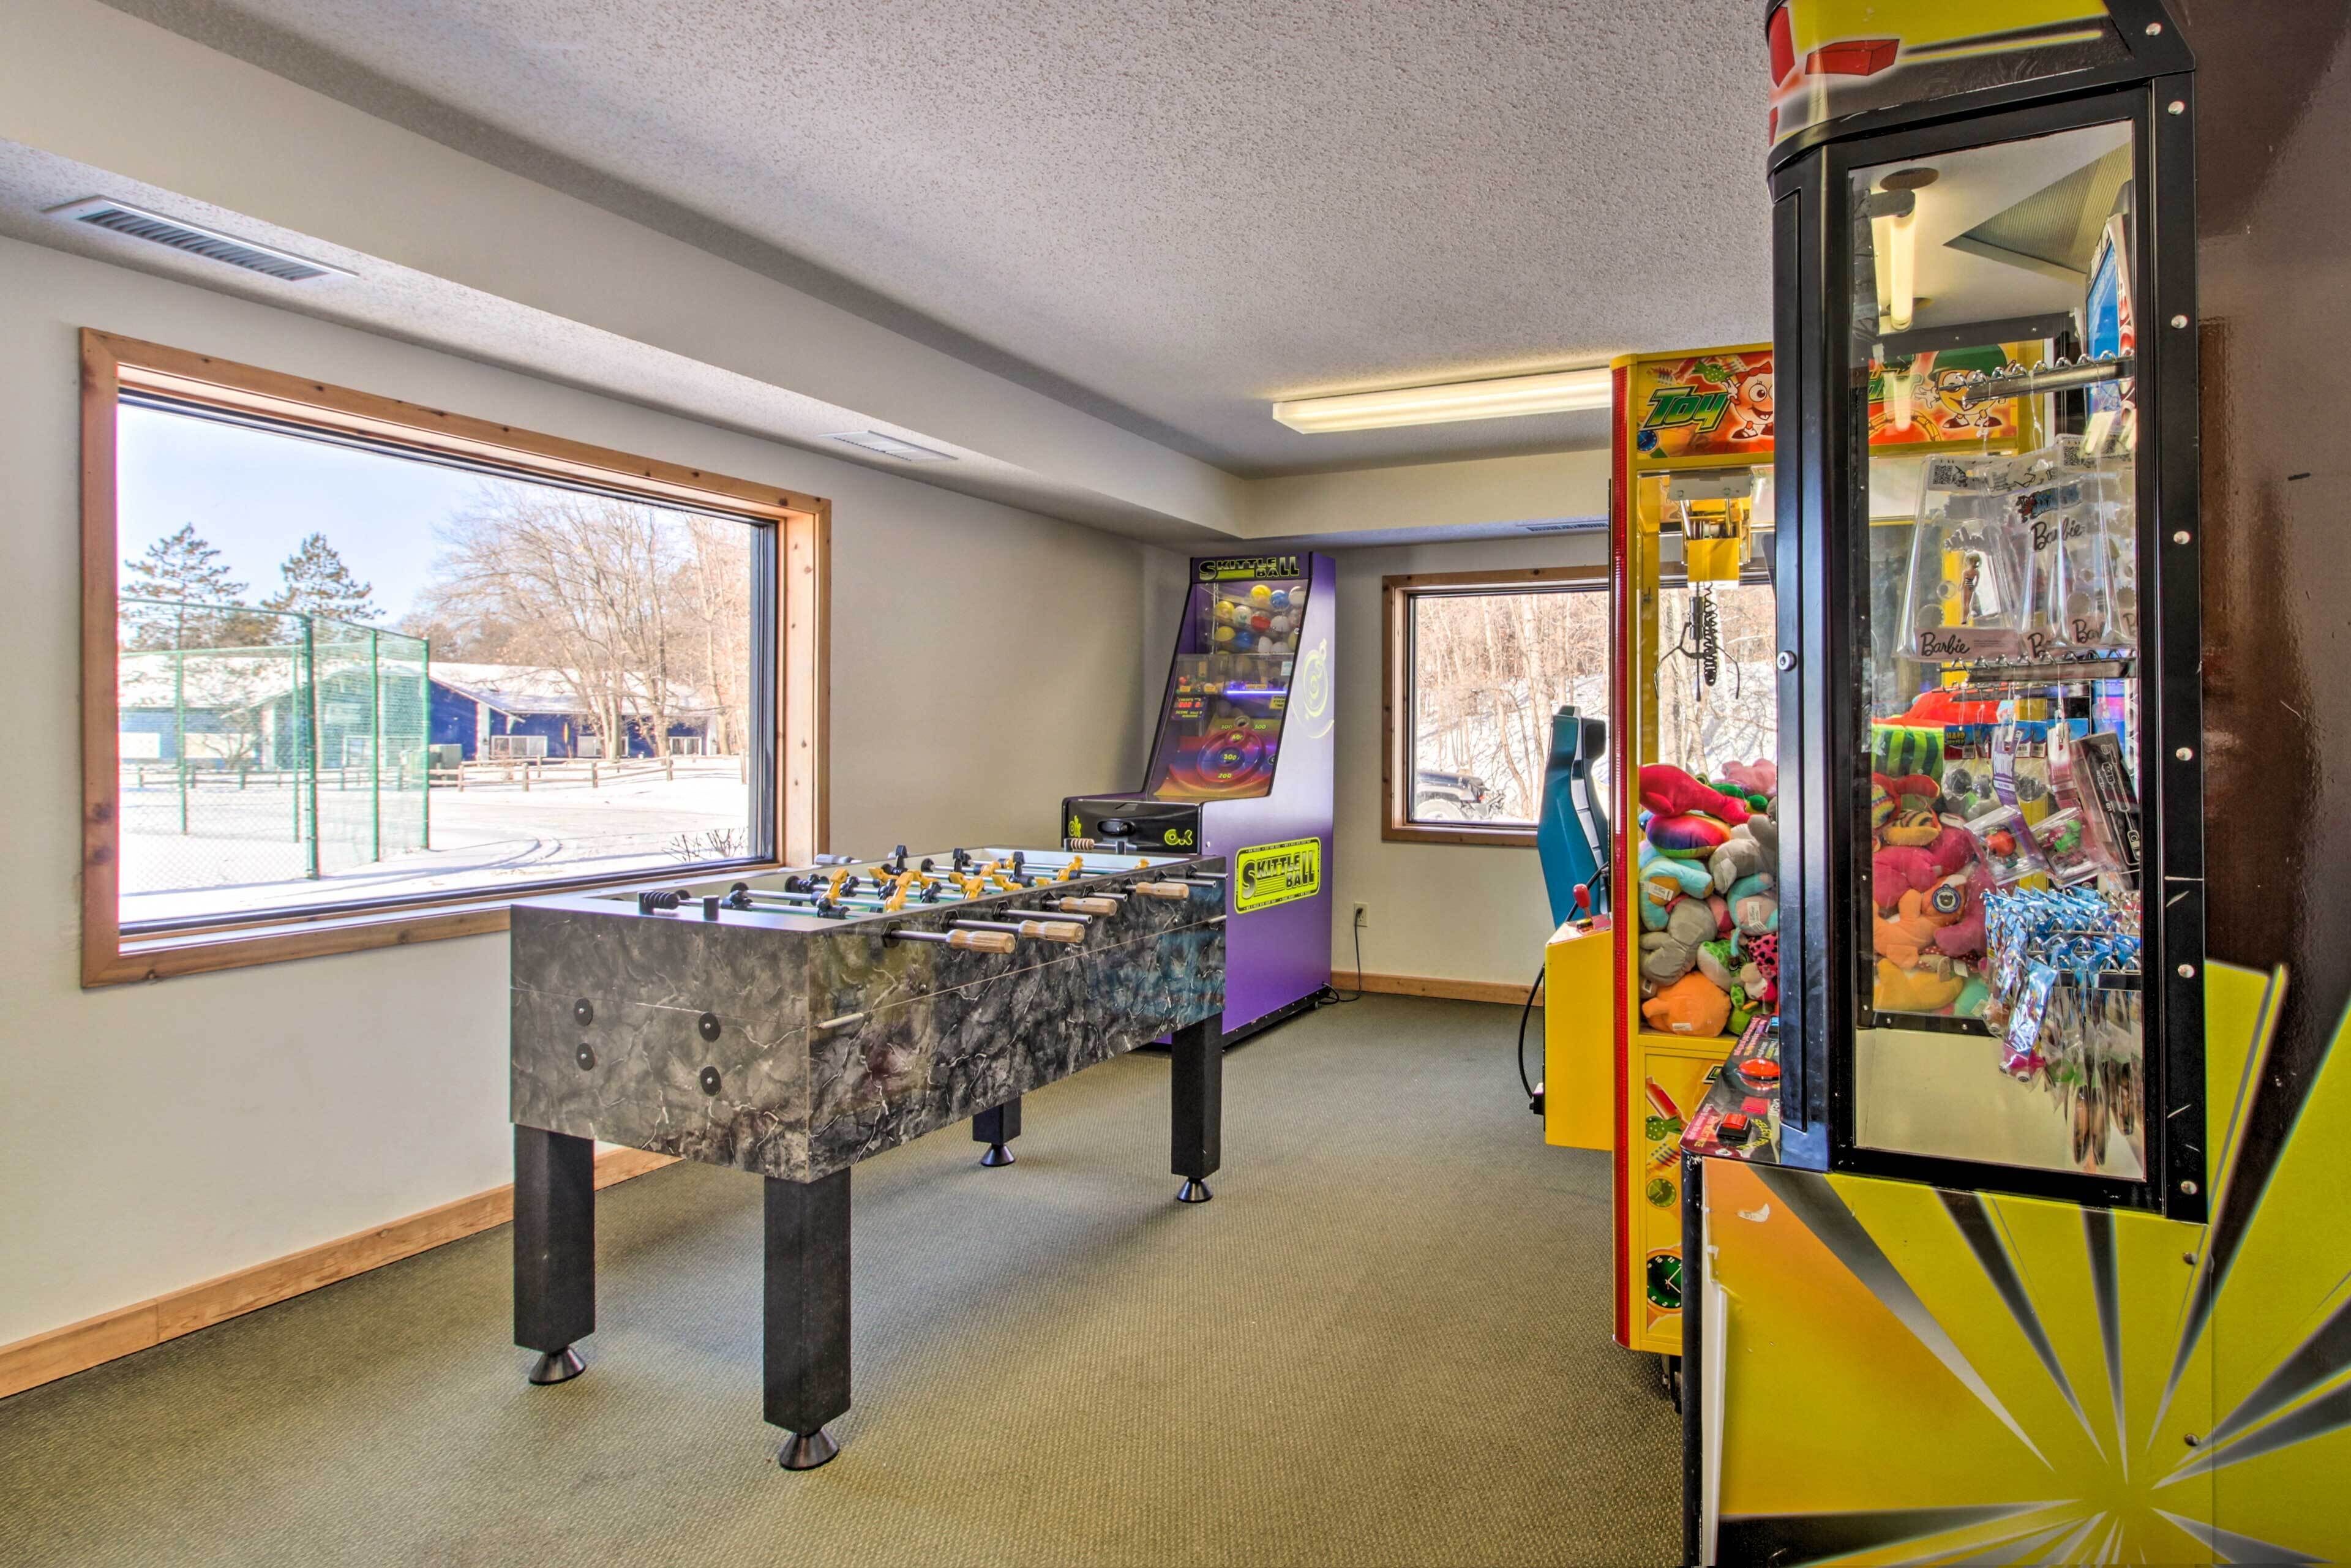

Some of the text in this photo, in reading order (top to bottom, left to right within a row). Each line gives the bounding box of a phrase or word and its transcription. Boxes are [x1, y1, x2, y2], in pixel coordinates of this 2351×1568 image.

[1641, 385, 1731, 432] Toy
[2031, 517, 2082, 550] Babie
[1199, 558, 1277, 580] SKITTLE
[1256, 557, 1300, 577] BALL
[1921, 632, 1970, 656] Barbie
[1242, 852, 1300, 900] SKITTLE
[1286, 850, 1316, 890] BALL
